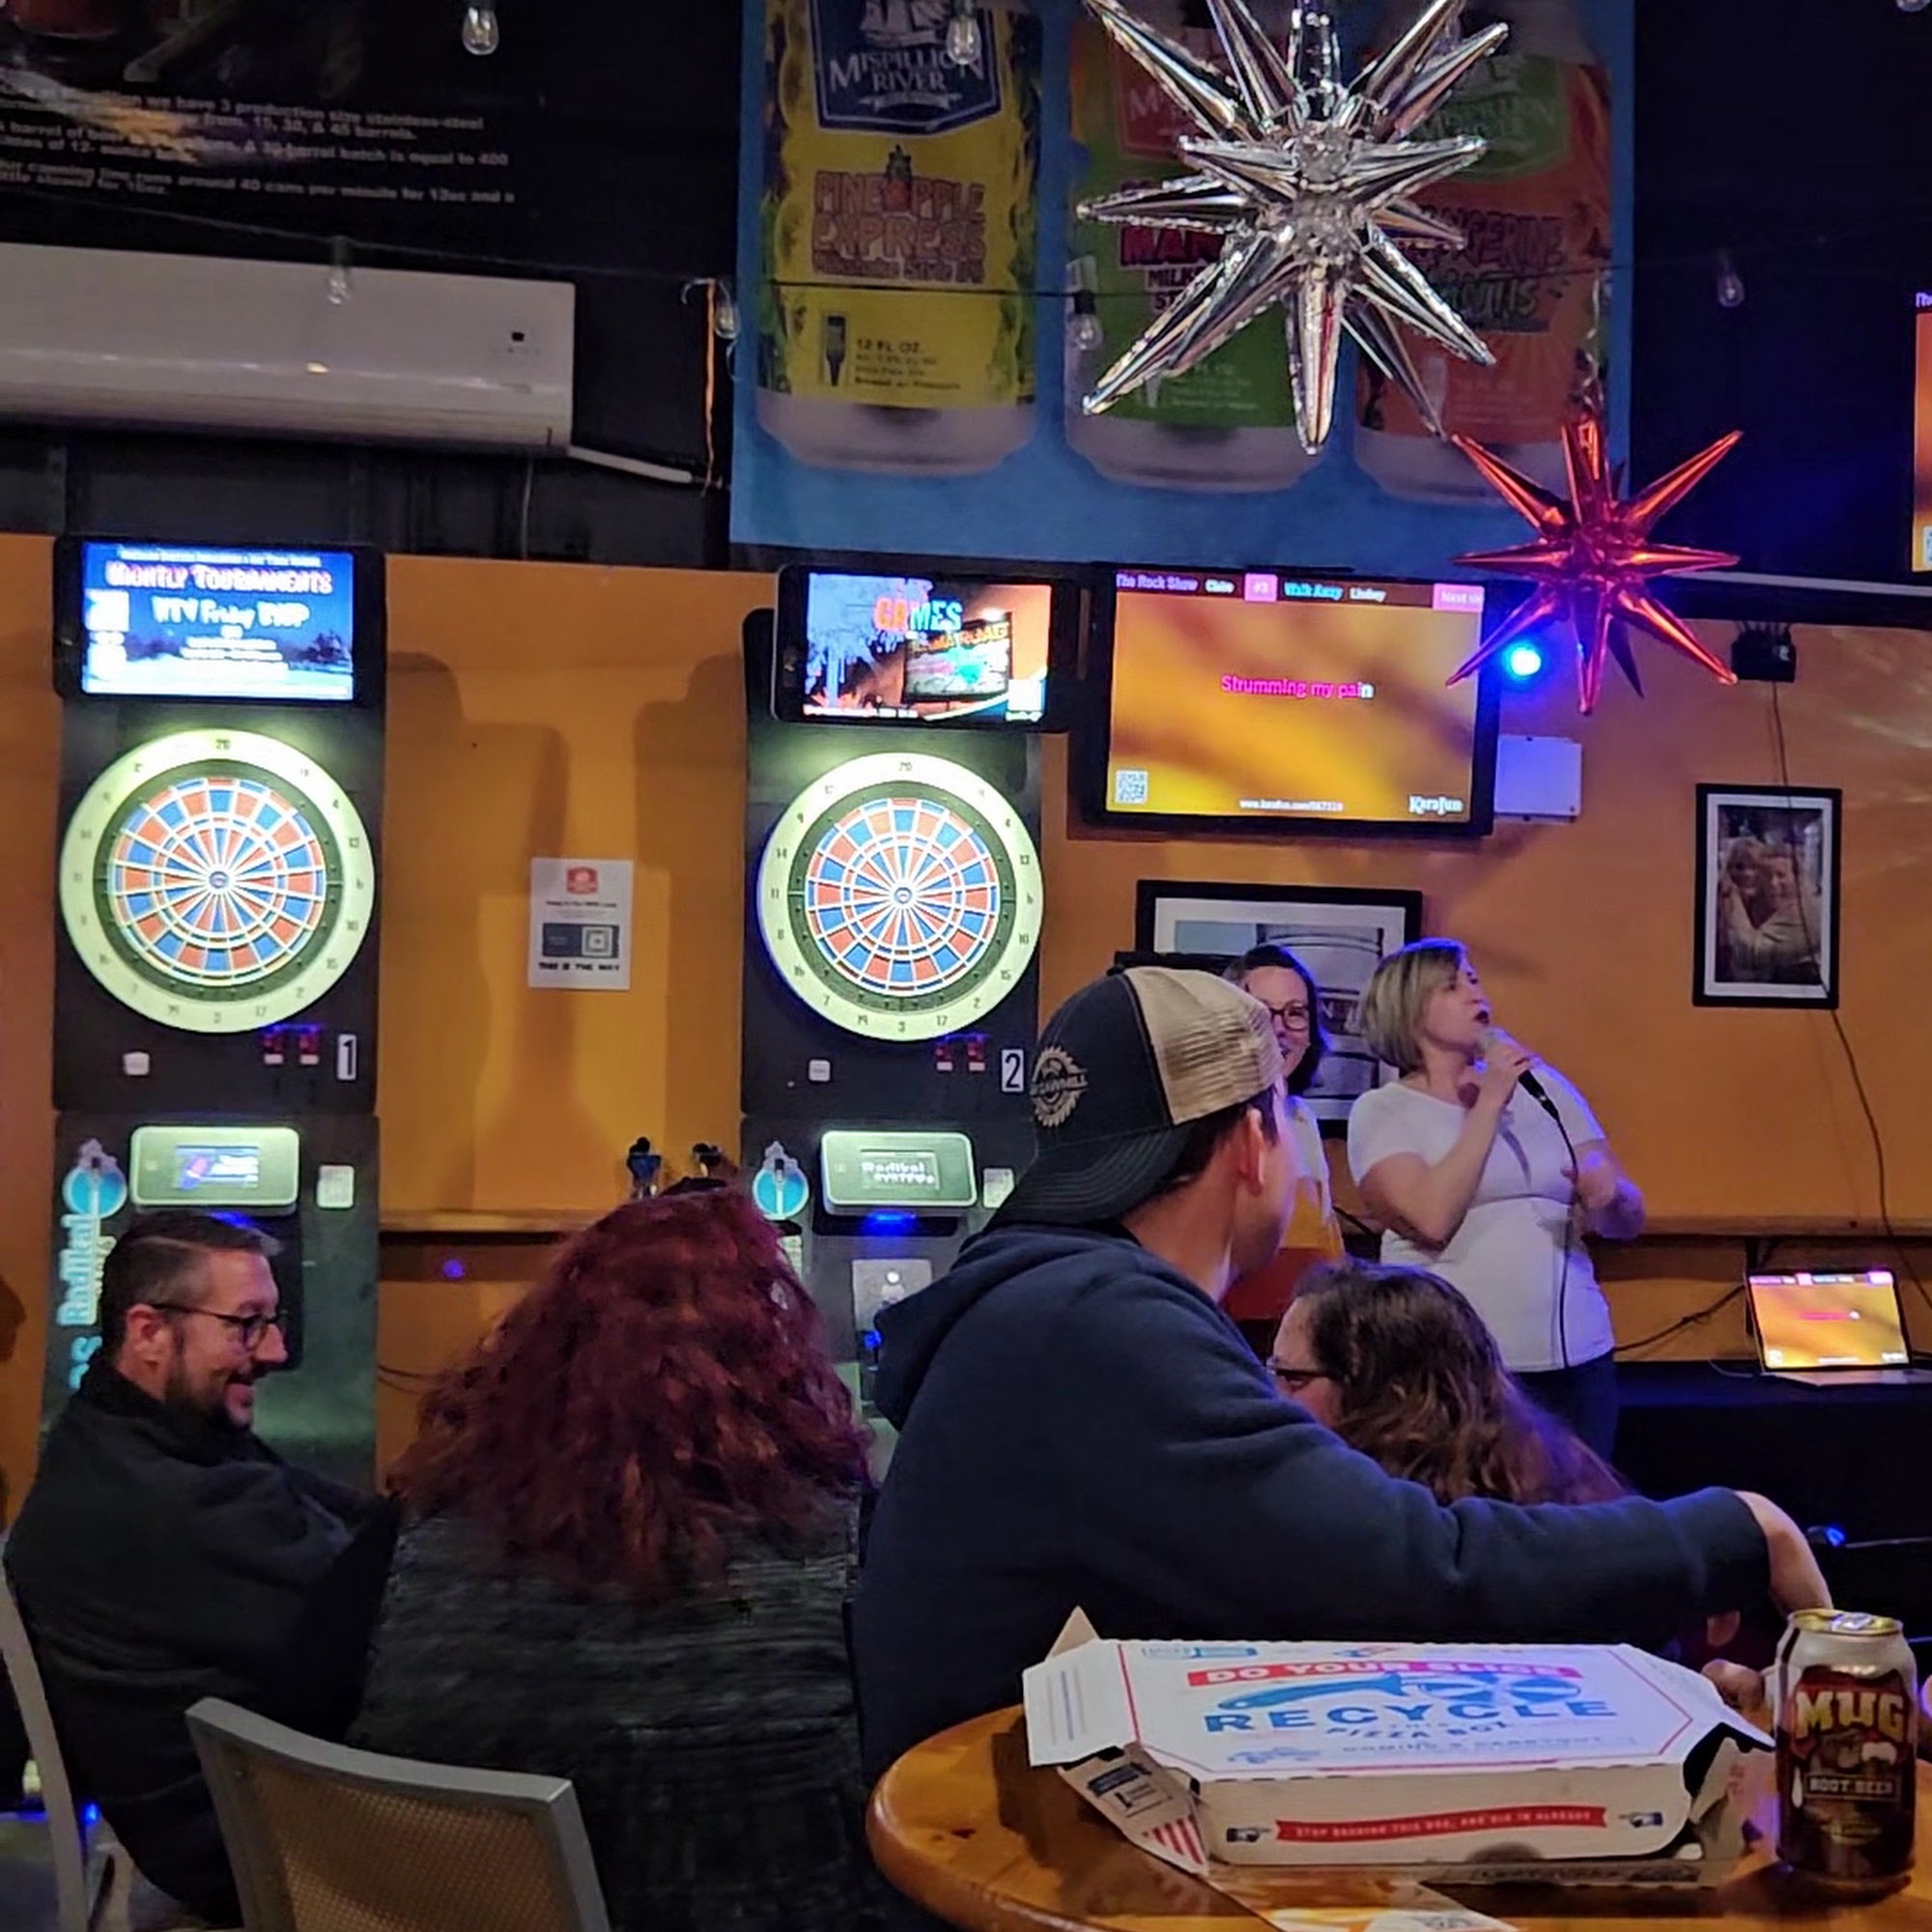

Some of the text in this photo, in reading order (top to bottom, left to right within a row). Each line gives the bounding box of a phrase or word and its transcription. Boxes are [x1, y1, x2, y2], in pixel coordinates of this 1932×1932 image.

[873, 69, 947, 92] RIVER
[813, 212, 985, 262] EXPRESS
[1116, 573, 1136, 587] The
[1138, 575, 1165, 589] Rock
[1167, 577, 1199, 591] Show
[1221, 674, 1375, 698] Strumming my pain
[1005, 1053, 1021, 1089] 2
[1208, 1666, 1269, 1683] DO
[1284, 1661, 1409, 1676] YOUR
[1204, 1699, 1618, 1733] RECYCLE
[1795, 1690, 1905, 1744] MUG
[1809, 1776, 1893, 1795] ROOT BEER
